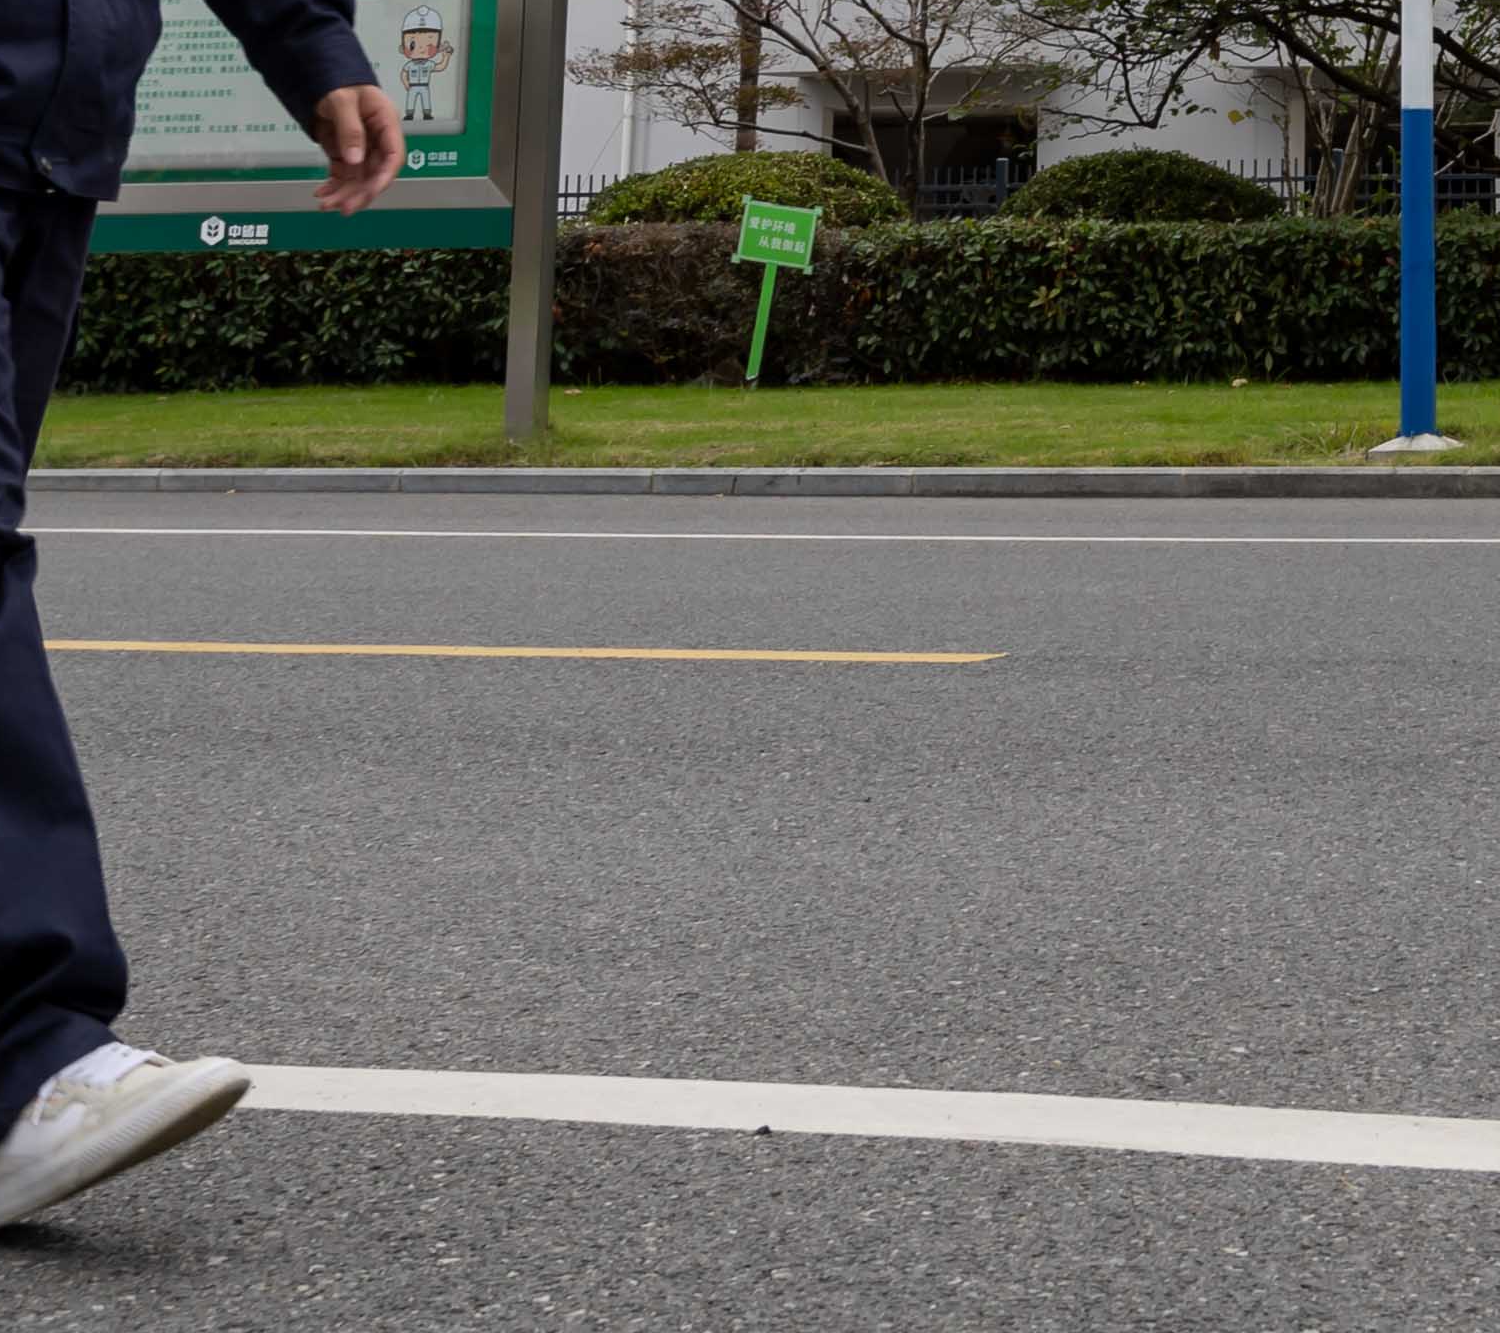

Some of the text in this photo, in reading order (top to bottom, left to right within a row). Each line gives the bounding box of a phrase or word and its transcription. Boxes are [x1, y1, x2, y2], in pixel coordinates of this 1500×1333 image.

[748, 216, 796, 235] 爱护环境
[758, 236, 805, 253] 从我做起
